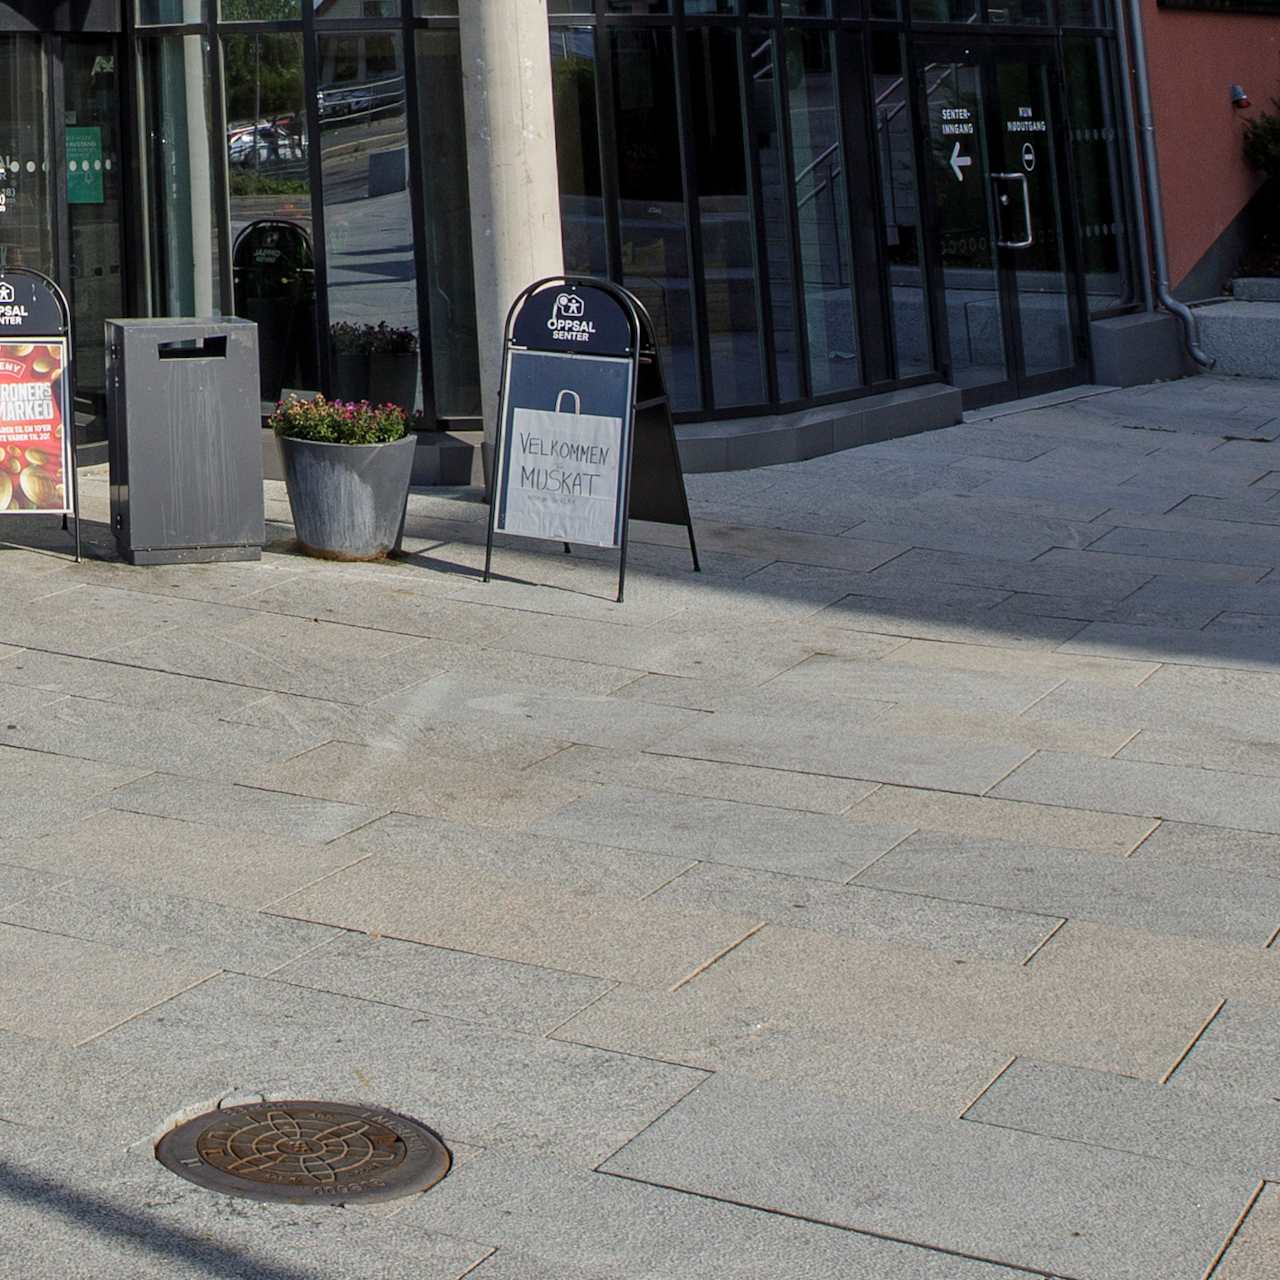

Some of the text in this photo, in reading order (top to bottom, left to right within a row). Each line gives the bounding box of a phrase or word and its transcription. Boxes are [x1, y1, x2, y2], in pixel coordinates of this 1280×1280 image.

[942, 108, 971, 120] SENTER-
[942, 123, 974, 134] INNGANG
[547, 319, 596, 333] OPPSAL
[553, 331, 590, 341] SENTER
[519, 432, 610, 466] VELKOMMEN
[521, 465, 600, 496] MUSKAT
